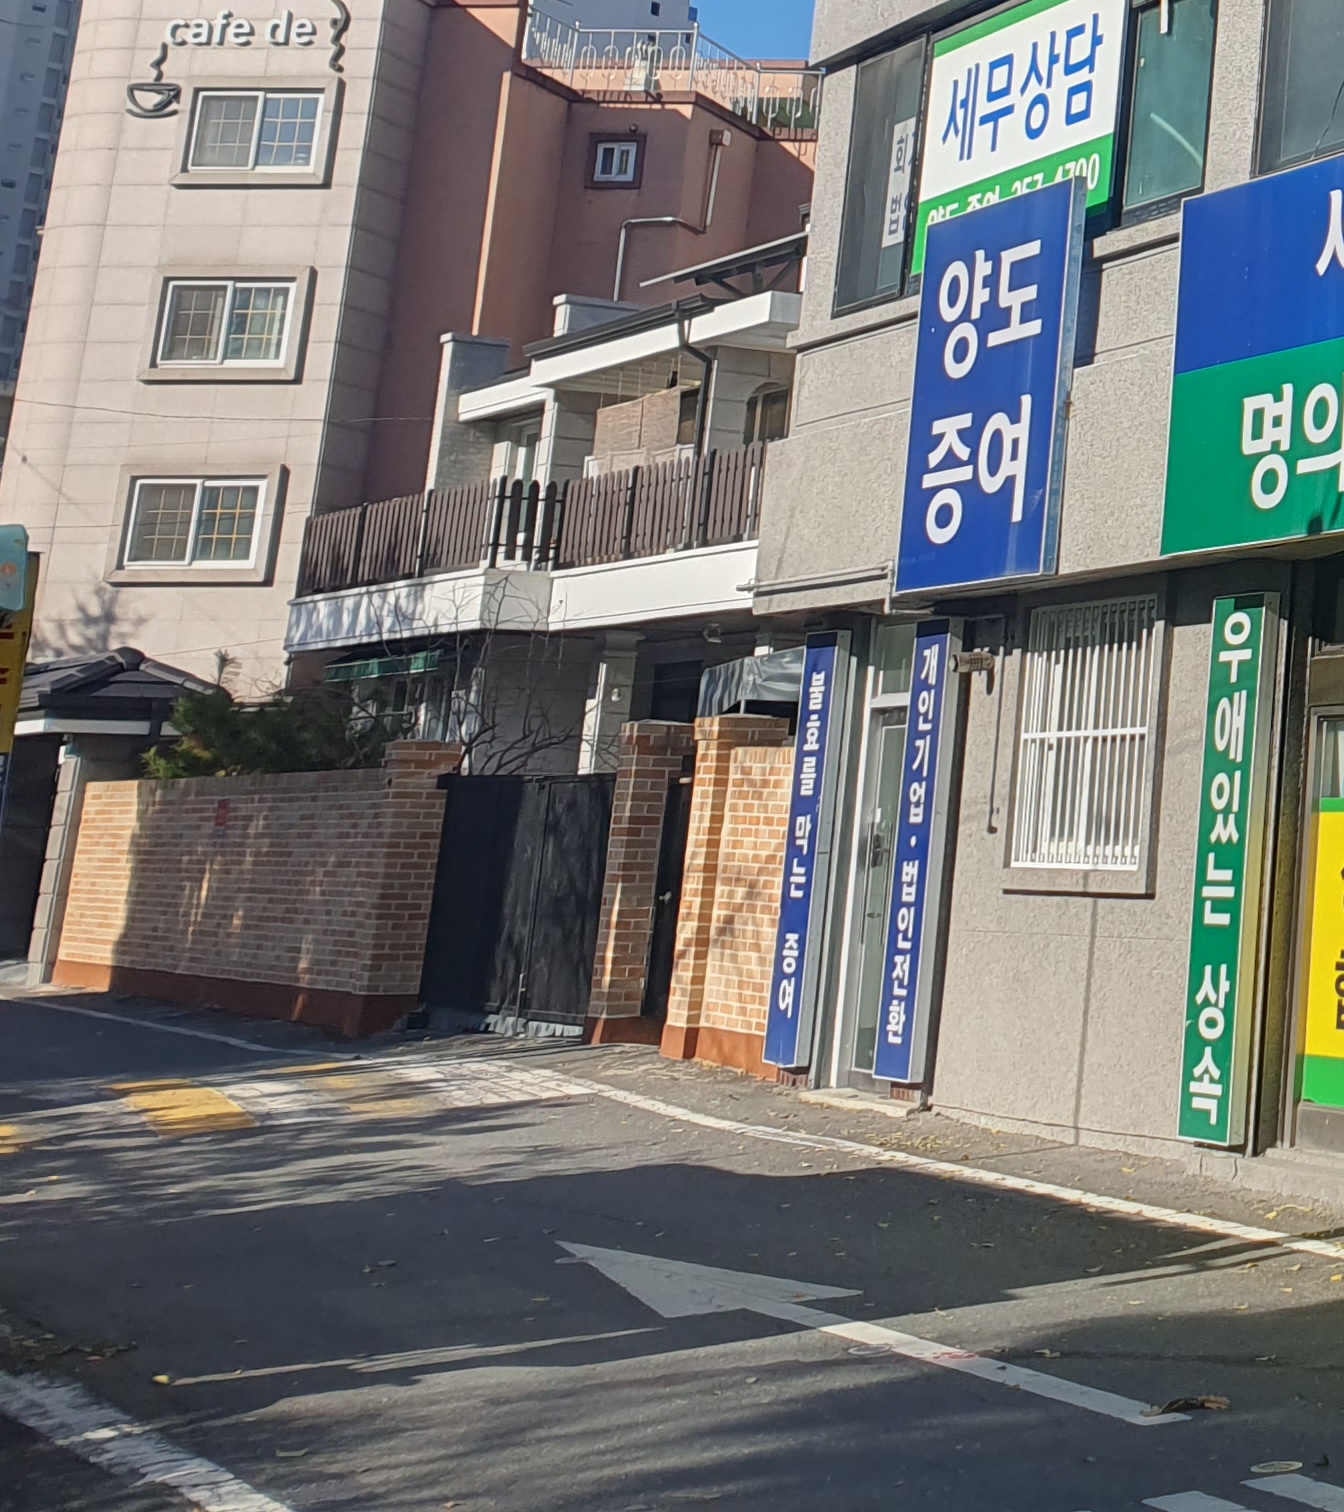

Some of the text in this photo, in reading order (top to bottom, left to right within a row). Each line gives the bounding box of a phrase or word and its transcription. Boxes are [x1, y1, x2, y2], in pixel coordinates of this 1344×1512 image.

[165, 10, 317, 46] cafe de
[941, 13, 1105, 161] 세무상담
[937, 237, 1045, 381] 양도
[920, 393, 1034, 546] 증여
[789, 814, 812, 899] 막는
[1189, 612, 1253, 1125] 우애있는 상속
[778, 932, 799, 1019] 증여
